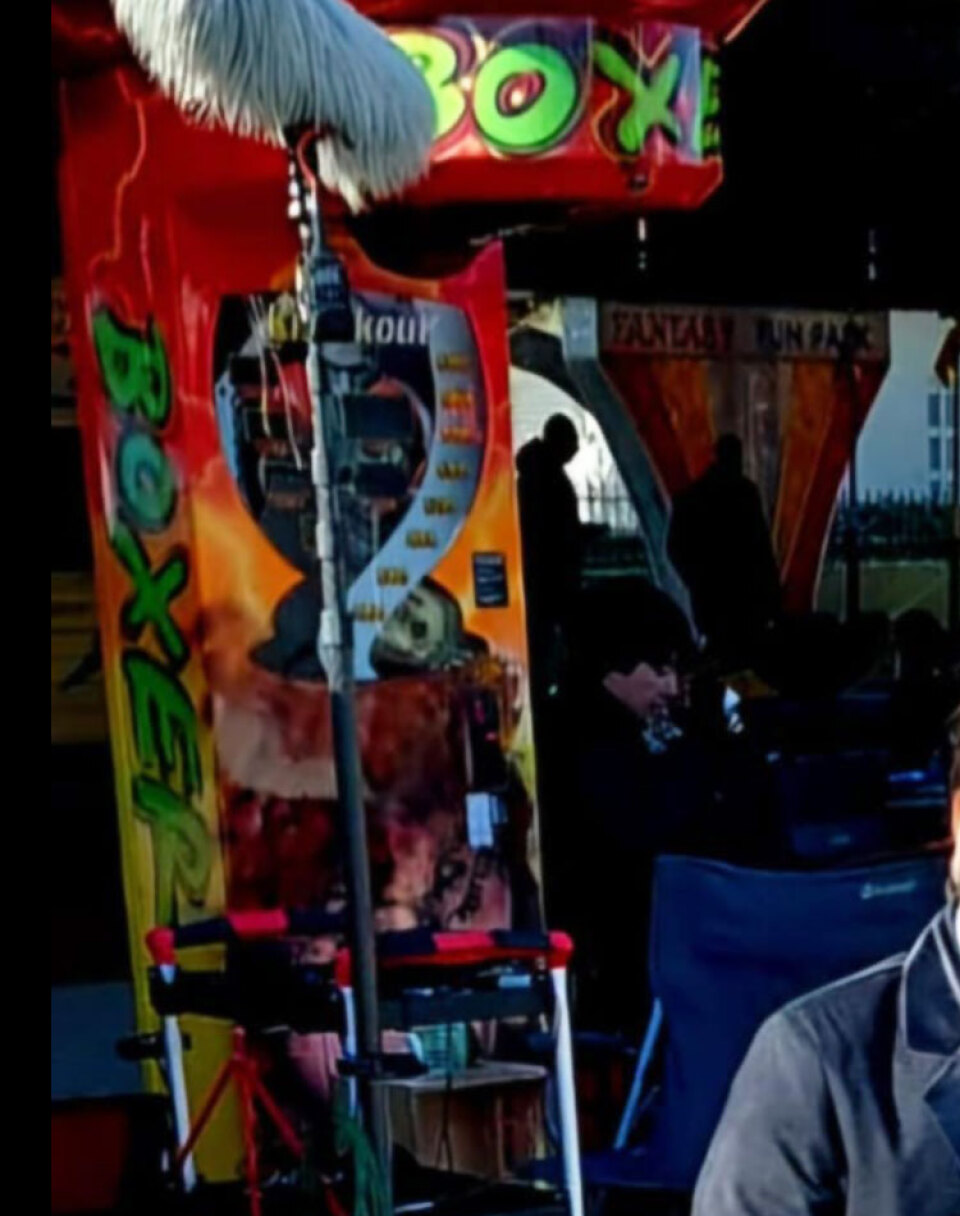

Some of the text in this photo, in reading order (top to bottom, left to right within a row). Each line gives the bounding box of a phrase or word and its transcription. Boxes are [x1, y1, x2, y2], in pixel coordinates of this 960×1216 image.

[611, 310, 735, 352] FANTASY
[809, 316, 873, 352] PAK
[92, 303, 211, 928] BOXER
